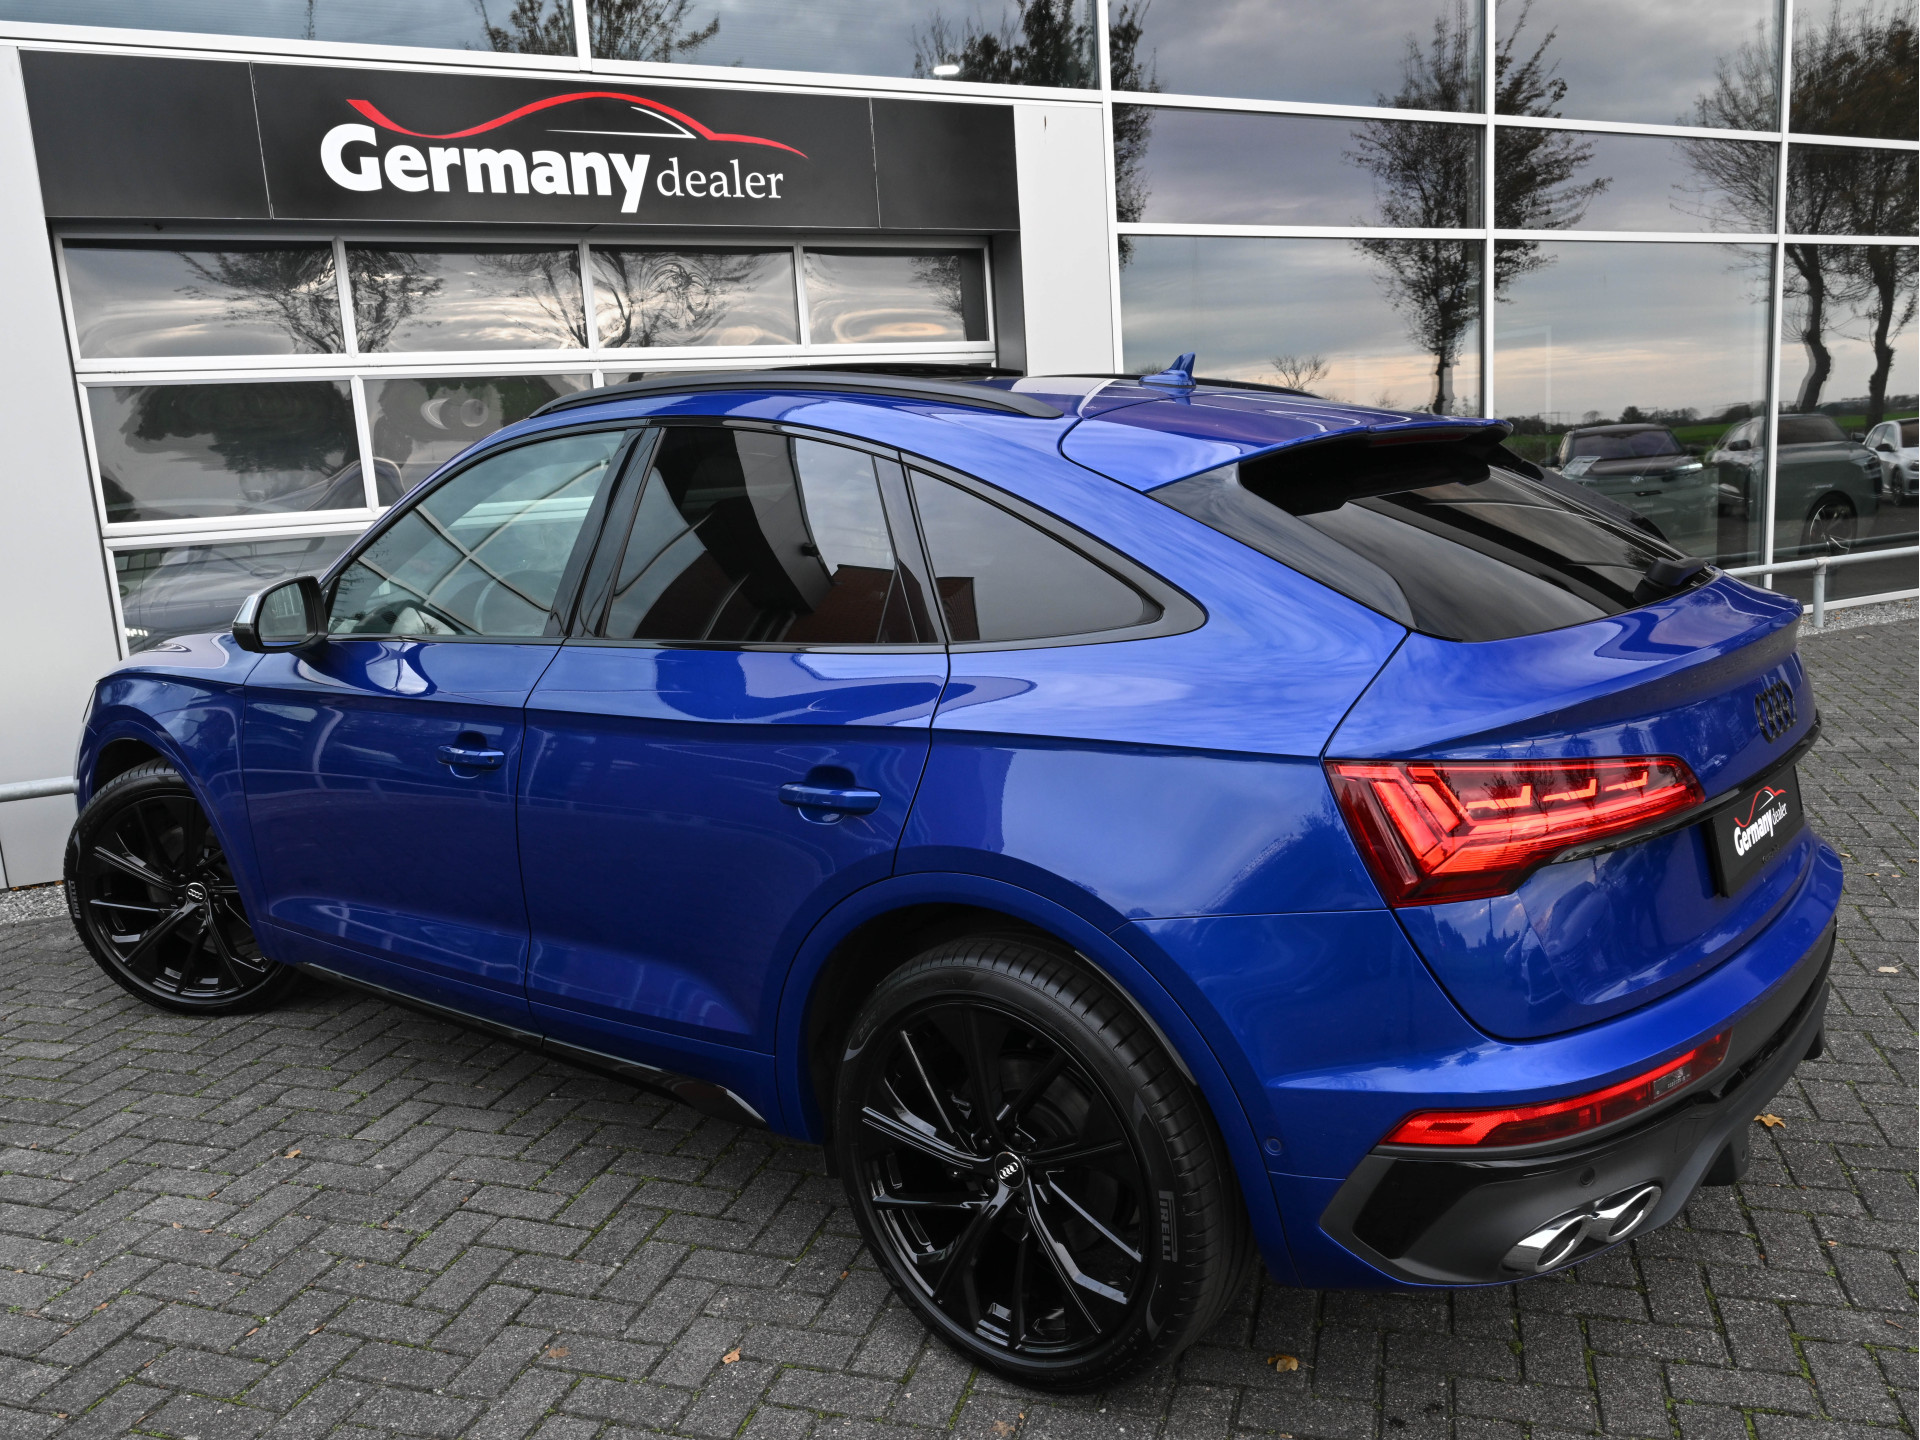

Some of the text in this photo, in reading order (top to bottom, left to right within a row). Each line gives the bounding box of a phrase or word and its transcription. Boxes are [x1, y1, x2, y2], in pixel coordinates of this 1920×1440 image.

[320, 123, 784, 213] Germany dealer
[1734, 809, 1774, 857] Germany
[1771, 801, 1788, 825] dealer
[1159, 1190, 1178, 1262] PIRELLI
